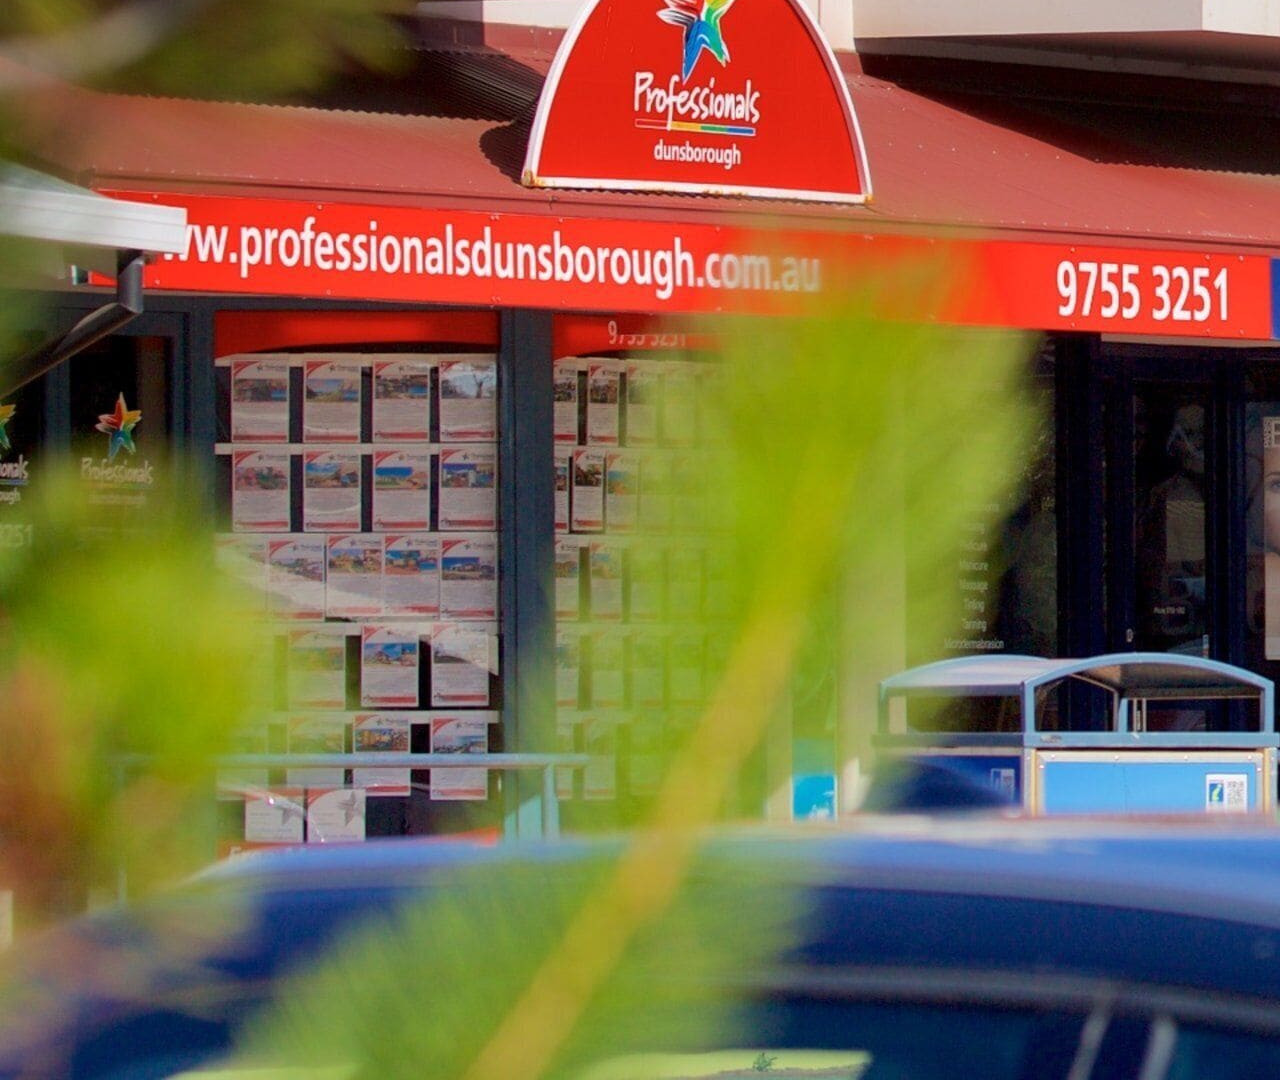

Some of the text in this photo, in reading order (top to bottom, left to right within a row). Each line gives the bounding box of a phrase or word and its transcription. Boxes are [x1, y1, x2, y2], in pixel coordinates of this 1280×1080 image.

[634, 71, 761, 131] Professionals
[653, 139, 741, 170] dunsborough
[1056, 259, 1228, 321] 9755 3251
[80, 456, 154, 484] Professionals
